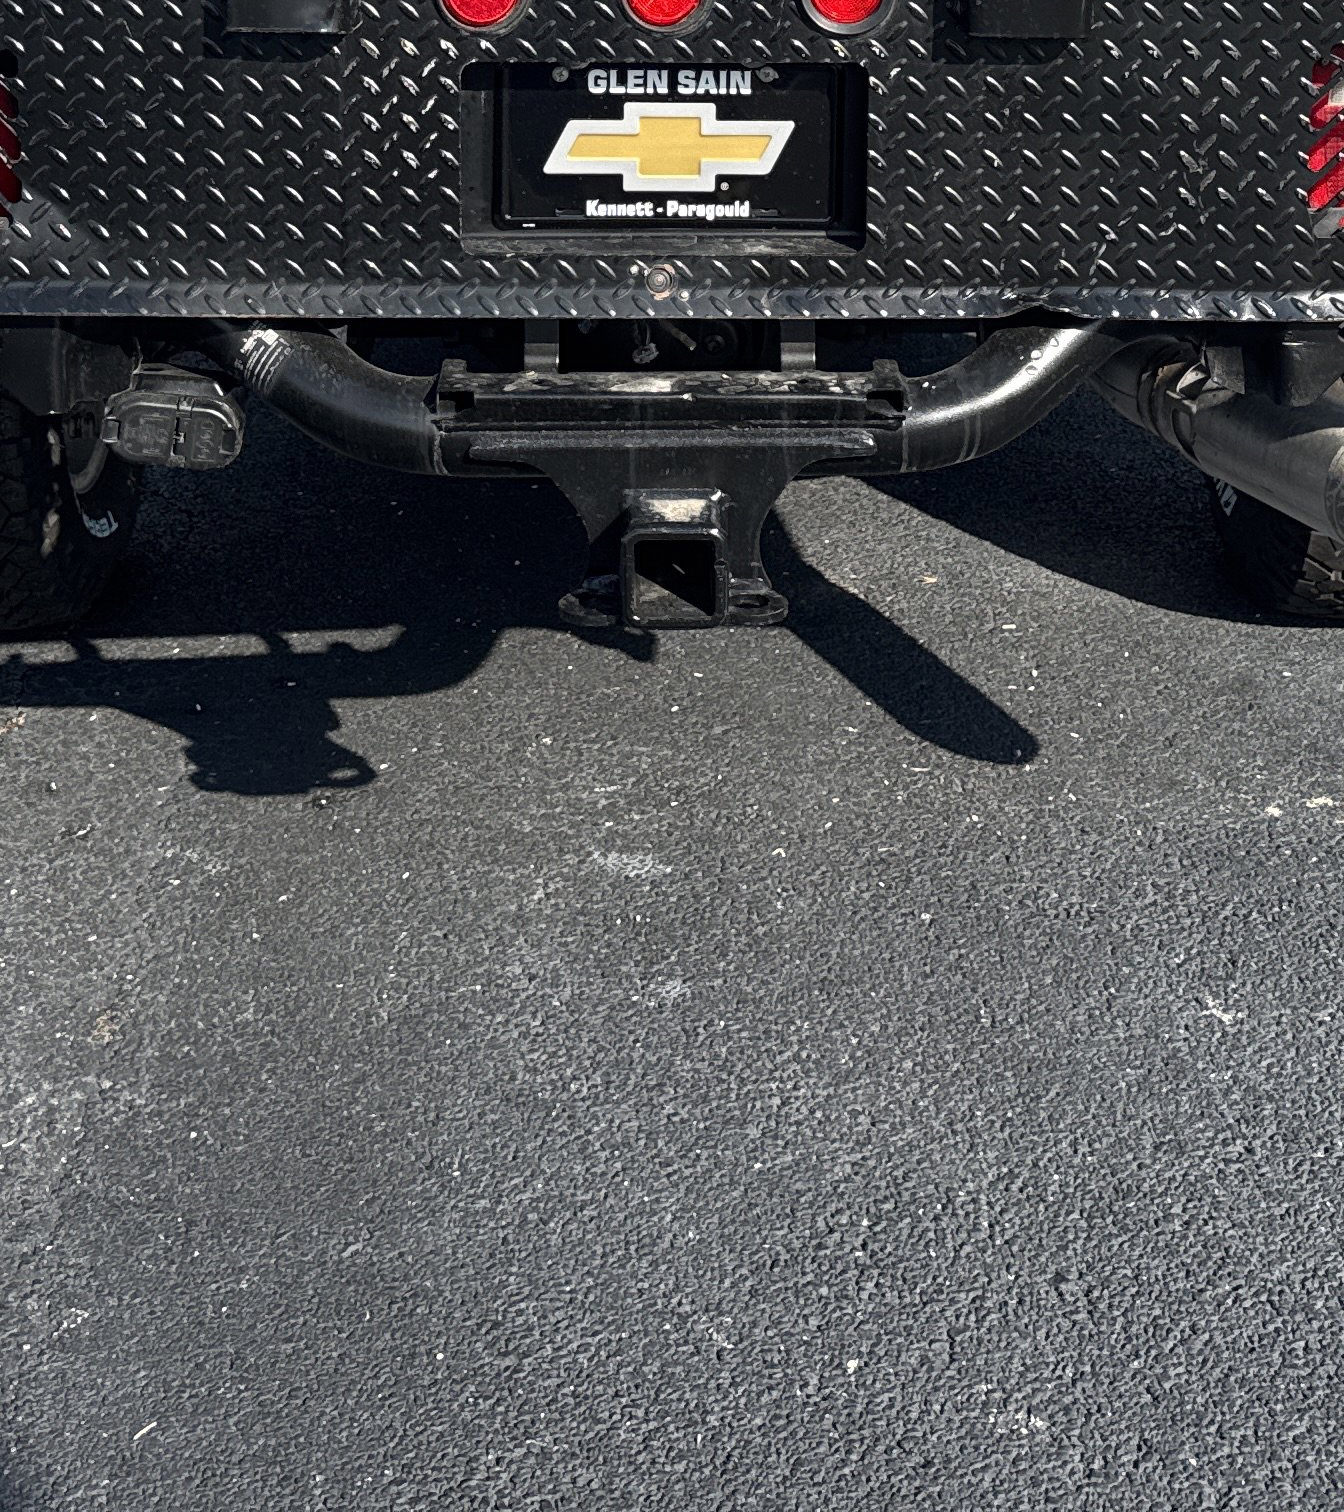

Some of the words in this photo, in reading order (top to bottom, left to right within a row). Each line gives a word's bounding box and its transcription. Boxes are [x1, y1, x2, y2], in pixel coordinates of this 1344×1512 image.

[587, 68, 669, 94] GLEN
[677, 69, 752, 95] SAIN
[586, 199, 654, 217] Kennett
[666, 199, 750, 221] Paragould
